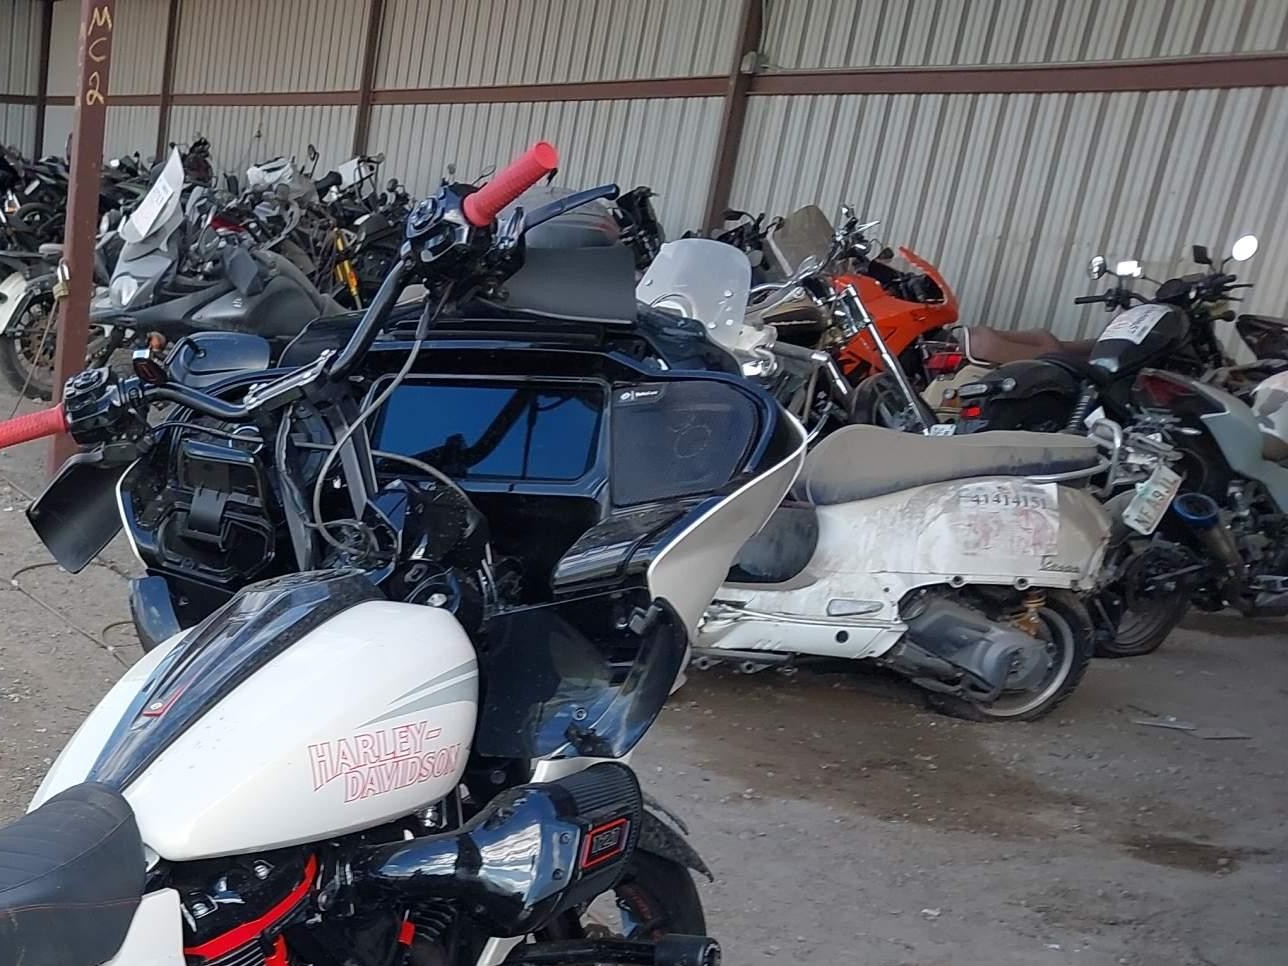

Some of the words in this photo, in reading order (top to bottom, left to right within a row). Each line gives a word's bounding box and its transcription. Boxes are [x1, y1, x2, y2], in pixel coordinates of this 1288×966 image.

[87, 6, 112, 105] MC2
[308, 721, 442, 792] HARLEY-
[344, 743, 461, 803] DAVIDSON
